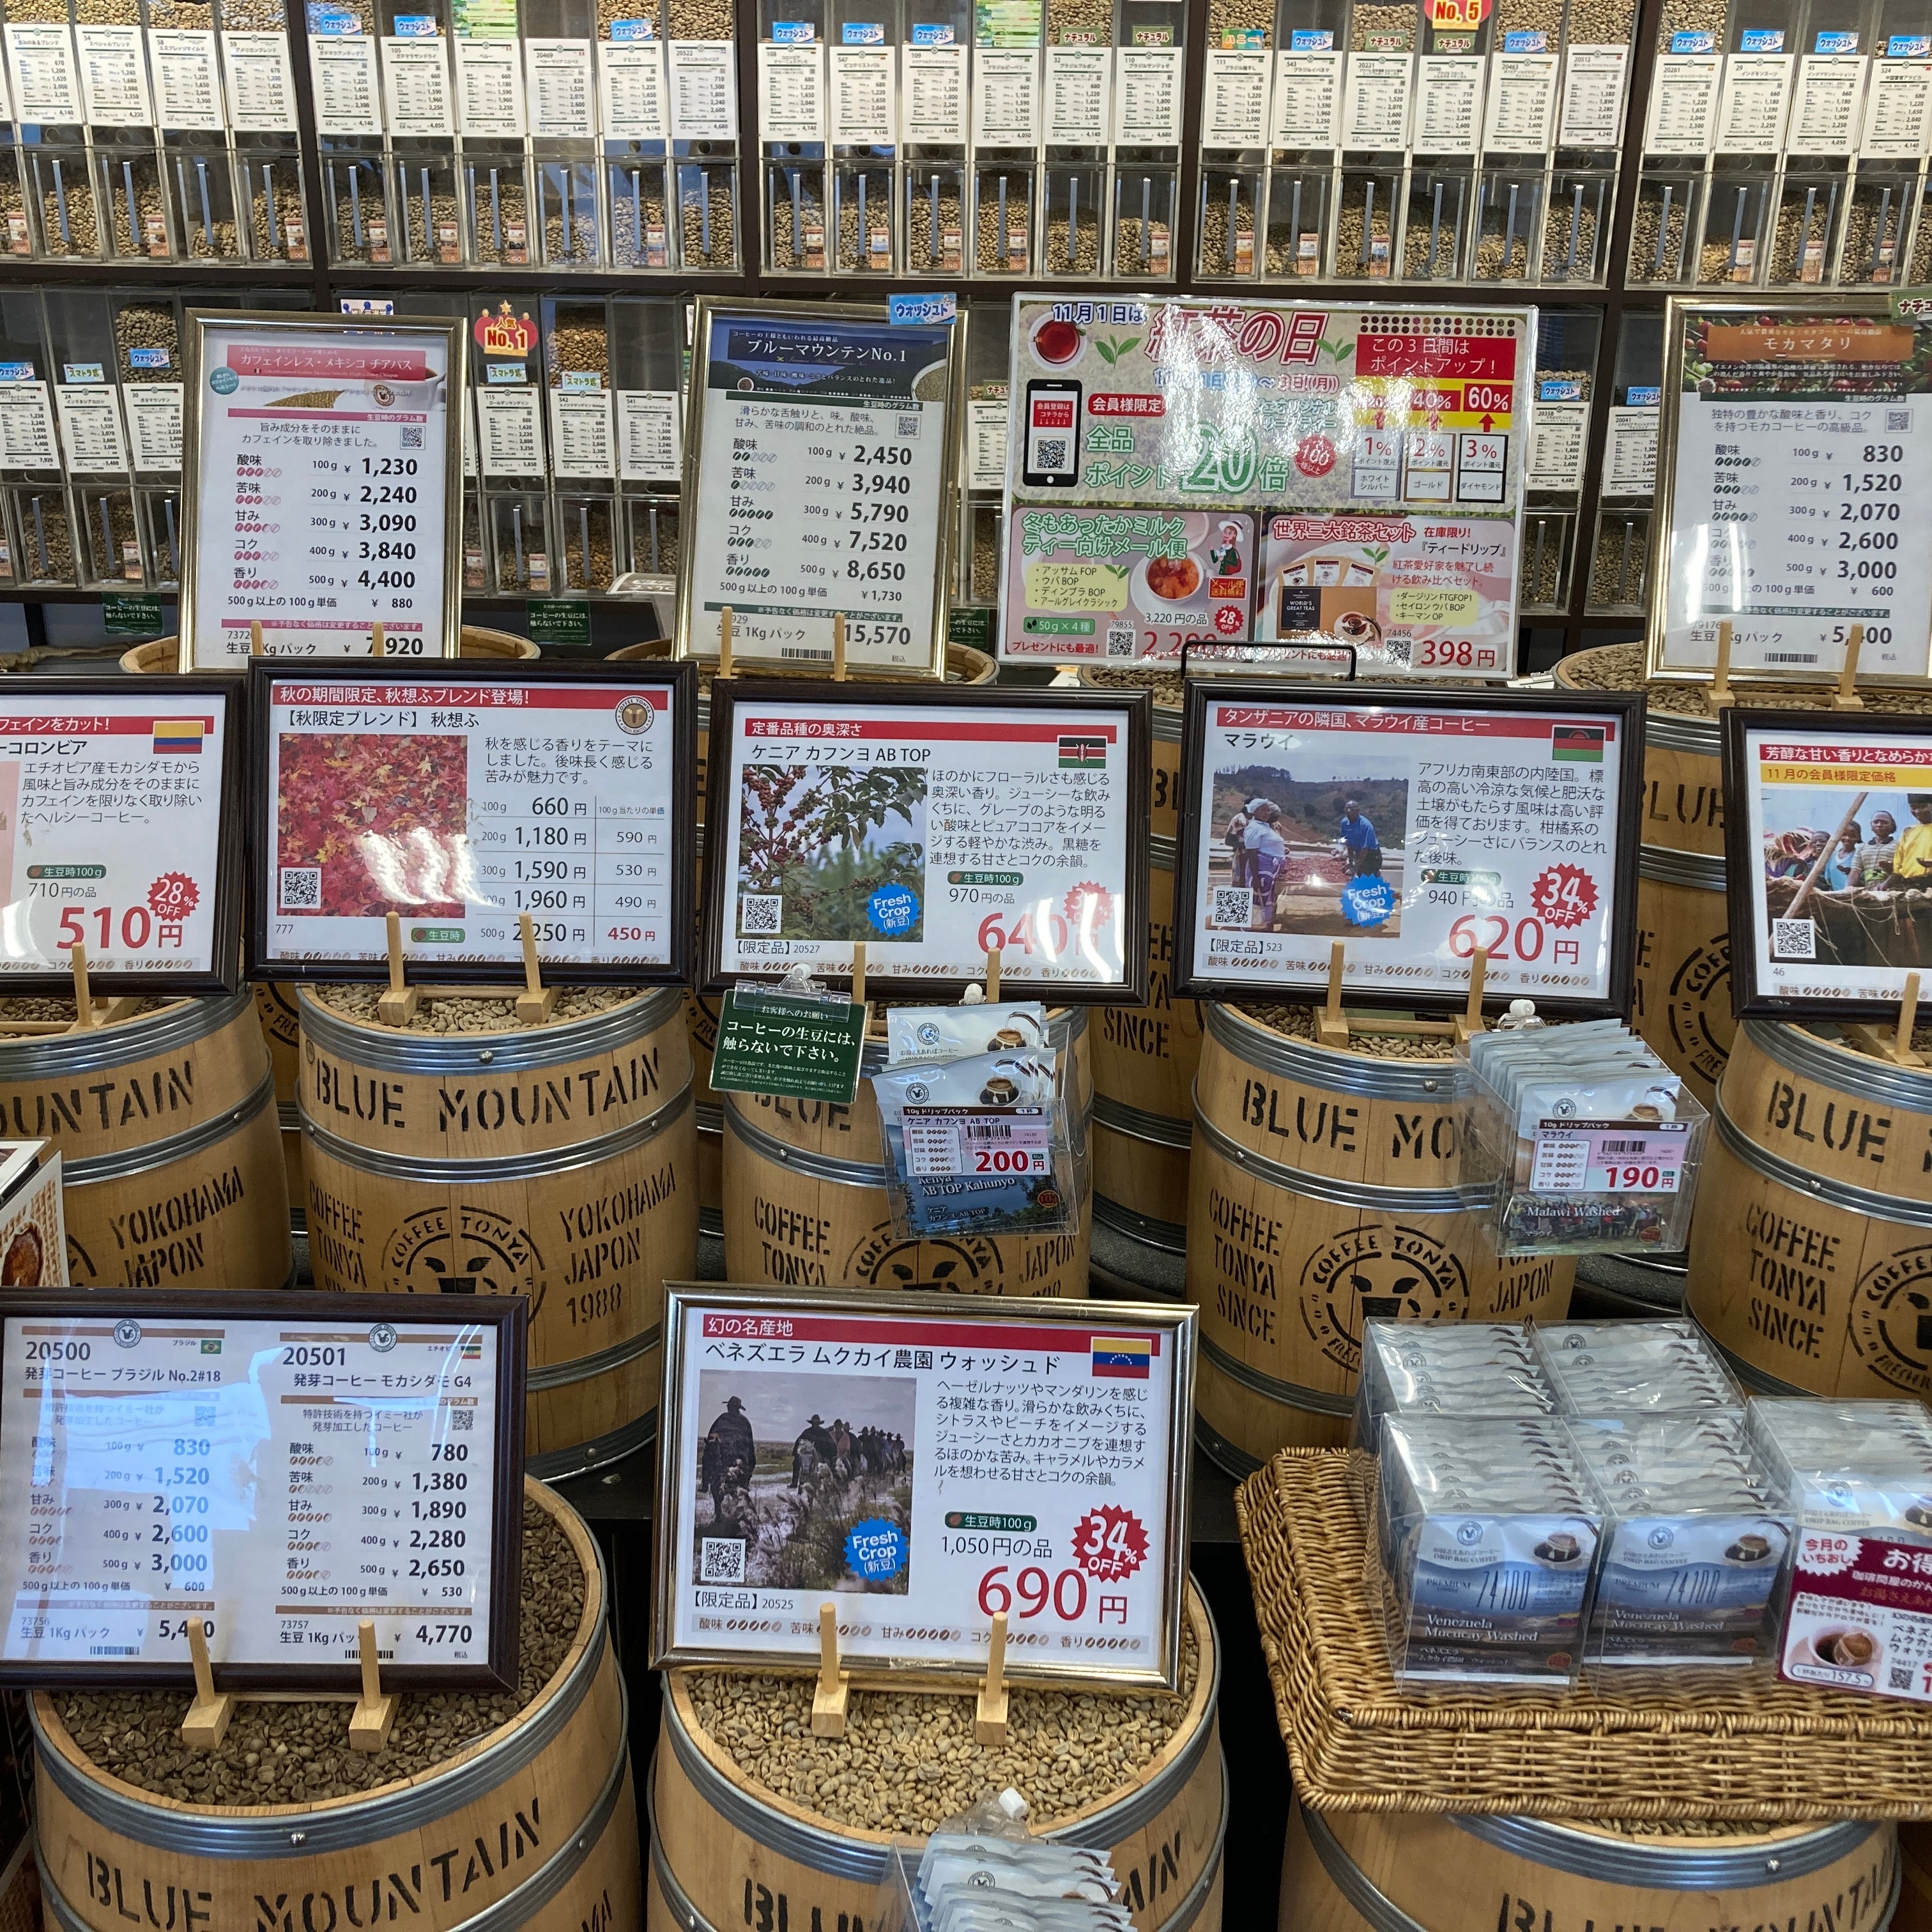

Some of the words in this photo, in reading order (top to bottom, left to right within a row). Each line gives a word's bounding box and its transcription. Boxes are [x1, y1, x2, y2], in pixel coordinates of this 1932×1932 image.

[1064, 33, 1096, 43] ナチュラル
[1137, 32, 1169, 42] ナチュラル
[1438, 39, 1470, 48] ナチュラル
[1764, 337, 1851, 351] モカマタリ
[1092, 397, 1162, 413] 会員様限定
[1468, 387, 1509, 410] 60%
[1712, 408, 1871, 421] 独特の豊かな酸味と香り、コク
[260, 424, 361, 434] 旨み成分をそのままに
[735, 419, 879, 436] 甘み、苦味の調和のとれた絶品。
[1714, 421, 1869, 434] を持つモカコーヒーの高級品。
[242, 434, 378, 448] カフェインを取り除きました。
[1086, 425, 1134, 452] 全品
[854, 445, 912, 466] 2,450
[1864, 445, 1903, 463] 830
[237, 455, 261, 465] 酸味
[362, 458, 417, 477] 1,230
[236, 482, 261, 493] 苦味
[360, 486, 417, 505] 2,240
[1460, 482, 1501, 491] ダイヤモンド
[731, 496, 754, 507] 甘み
[850, 503, 908, 523] 5,790
[1840, 503, 1899, 523] 2,070
[1022, 512, 1186, 537] 冬もあったかミルク
[1273, 520, 1416, 542] 世界三大銘茶セット
[235, 539, 257, 549] コク
[358, 542, 415, 561] 3,840
[1023, 535, 1187, 559] ティー向けメール便
[727, 554, 749, 565] 香り
[848, 560, 905, 581] 8,650
[1393, 560, 1494, 572] 紅茶愛好家を魅了し続
[1837, 561, 1897, 580] 3,000
[1393, 574, 1484, 587] ける飲み比べセット。
[392, 599, 412, 608] 880
[1439, 594, 1472, 602] FTGFOP1
[1110, 620, 1133, 629] 79855
[770, 628, 806, 640] パック
[845, 624, 910, 645] 15,570
[1422, 640, 1472, 667] 398
[431, 712, 480, 728] 秋想ふ
[752, 721, 861, 737] 定番品種の奥深さ
[1225, 708, 1490, 732] タンザニアの隣国、マラウイ産コーヒー
[486, 737, 653, 753] 秋を感じる香りをテーマに
[752, 744, 799, 760] ケニア
[806, 746, 870, 762] カフンヨ
[876, 747, 896, 762] AB
[900, 747, 930, 762] TOP
[24, 761, 199, 774] エチオピア産モカシダモから
[487, 753, 652, 770] しました。後味長く感じる
[933, 769, 1110, 786] ほのかにフローラルさも感じる
[1419, 762, 1604, 784] アフリカ南東部の内陸国。標
[21, 794, 202, 808] カフェインを限りなく取り除い
[532, 797, 568, 816] 660
[1416, 798, 1604, 818] 土壌がもたらす風味は高い評
[932, 802, 1106, 819] くちに、グレープのような明る
[515, 826, 568, 847] 1,180
[616, 831, 643, 843] 590
[930, 852, 1089, 868] 連想する甘さとコクの余韻。
[874, 893, 912, 908] Fresh
[878, 904, 911, 920] Crop
[1545, 907, 1575, 921] OFF
[56, 907, 151, 949] 510
[158, 925, 182, 947] 円
[276, 924, 293, 934] 777
[608, 928, 641, 942] 450
[793, 945, 820, 954] 20527
[1450, 916, 1544, 962] 620
[1554, 939, 1579, 965] 円
[1773, 968, 1784, 976] 46
[762, 1005, 829, 1020] お客様へのお願い
[727, 1021, 855, 1046] コーヒーの生豆には、
[1103, 1006, 1171, 1059] SINCE
[723, 1036, 839, 1063] 触らないで下さい。
[316, 1057, 405, 1128] BLUE
[438, 1047, 659, 1132] MOUNTAIN
[1767, 1079, 1891, 1163] BLUE
[1542, 1131, 1573, 1139] マラウイ
[976, 1150, 1029, 1172] 200
[966, 1177, 1015, 1192] Kahunyo
[1606, 1166, 1659, 1189] 190
[560, 1162, 676, 1243] YOKOHAMA
[1527, 1206, 1570, 1217] Malawi
[1574, 1205, 1621, 1217] Washed
[309, 1179, 364, 1245] COFFEE
[1213, 1233, 1276, 1301] TONYA
[567, 1282, 622, 1326] 1988
[708, 1317, 793, 1338] 幻の名産地
[26, 1340, 91, 1361] 20500
[282, 1347, 346, 1367] 20501
[707, 1344, 806, 1365] ベネズエラ
[814, 1347, 933, 1371] ムクカイ農園
[939, 1353, 1060, 1374] ウォッシュド
[294, 1372, 377, 1388] 発芽コーヒー
[454, 1374, 472, 1388] G4
[937, 1379, 1148, 1402] ヘーゼルナッツやマンダリンを感じ
[936, 1413, 1147, 1436] シトラスやピーチをイメージする
[174, 1439, 210, 1457] 830
[432, 1444, 468, 1462] 780
[934, 1464, 1119, 1487] ルを想わせる甘さとコクの余韻。
[941, 1536, 990, 1556] 1,050
[992, 1538, 1052, 1559] 円の品
[1805, 1538, 1848, 1551] 今月の
[409, 1560, 465, 1579] 2,650
[1088, 1556, 1122, 1576] OFF
[979, 1565, 1086, 1623] 690
[1099, 1595, 1128, 1625] 円
[762, 1598, 794, 1611] 20525
[281, 1620, 309, 1630] 73757
[1427, 1614, 1492, 1630] Venezuela
[416, 1624, 472, 1646] 4,770
[1487, 1630, 1538, 1641] Washed
